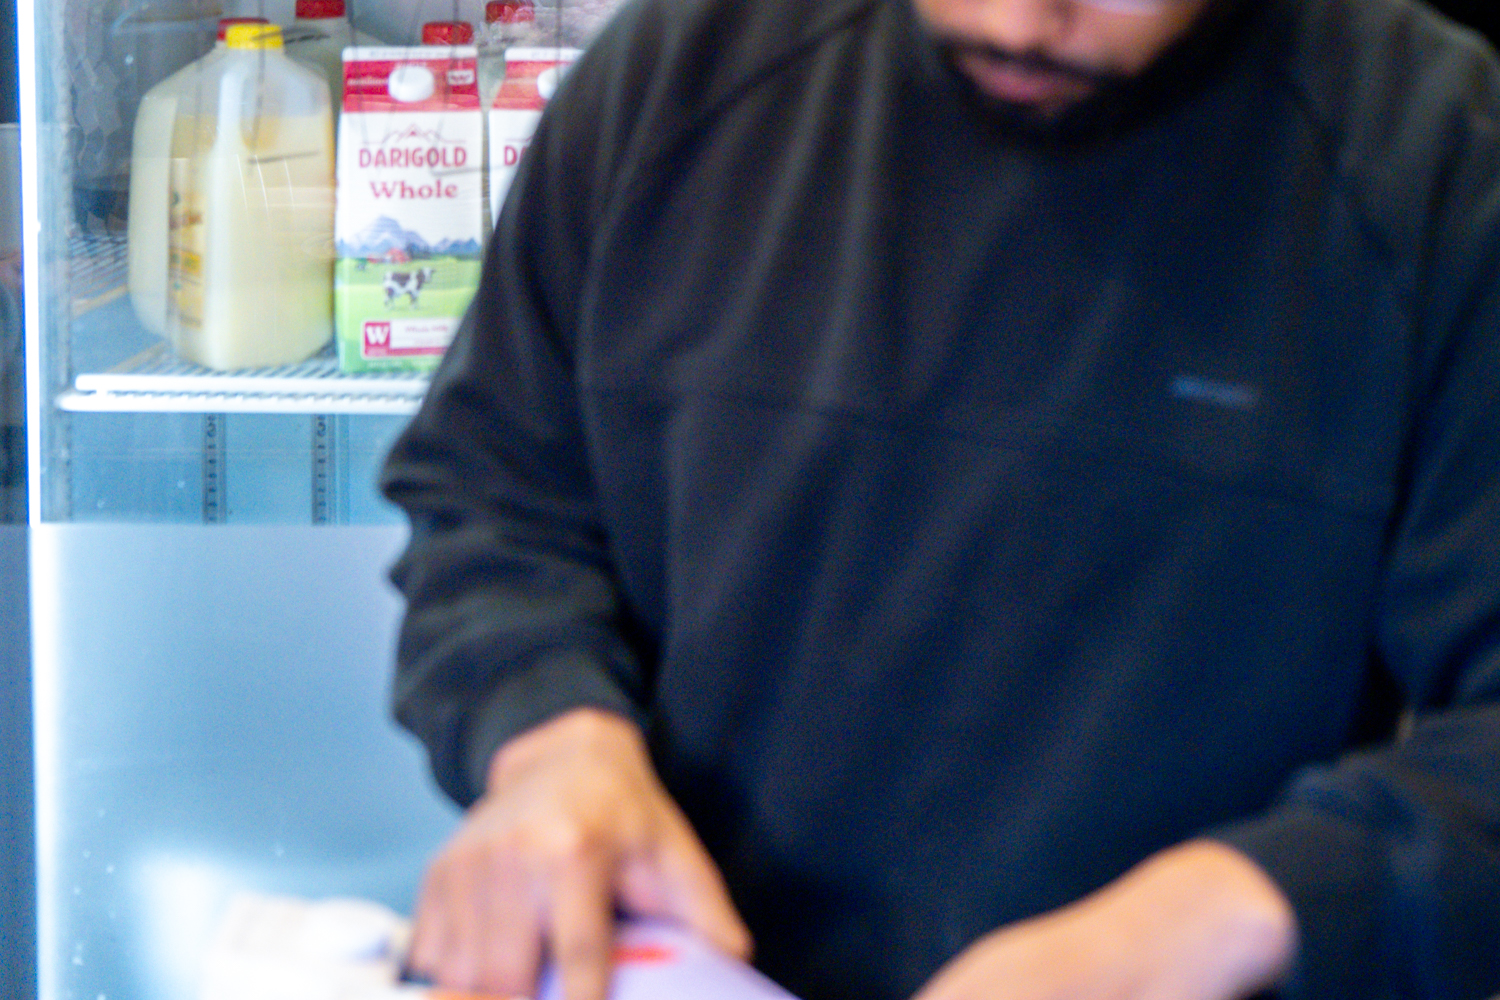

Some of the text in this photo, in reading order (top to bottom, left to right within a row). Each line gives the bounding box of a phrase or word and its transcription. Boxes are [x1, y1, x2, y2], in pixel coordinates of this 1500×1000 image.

[359, 147, 467, 168] DARIGOLD
[370, 180, 458, 199] Whole
[366, 325, 389, 345] W
